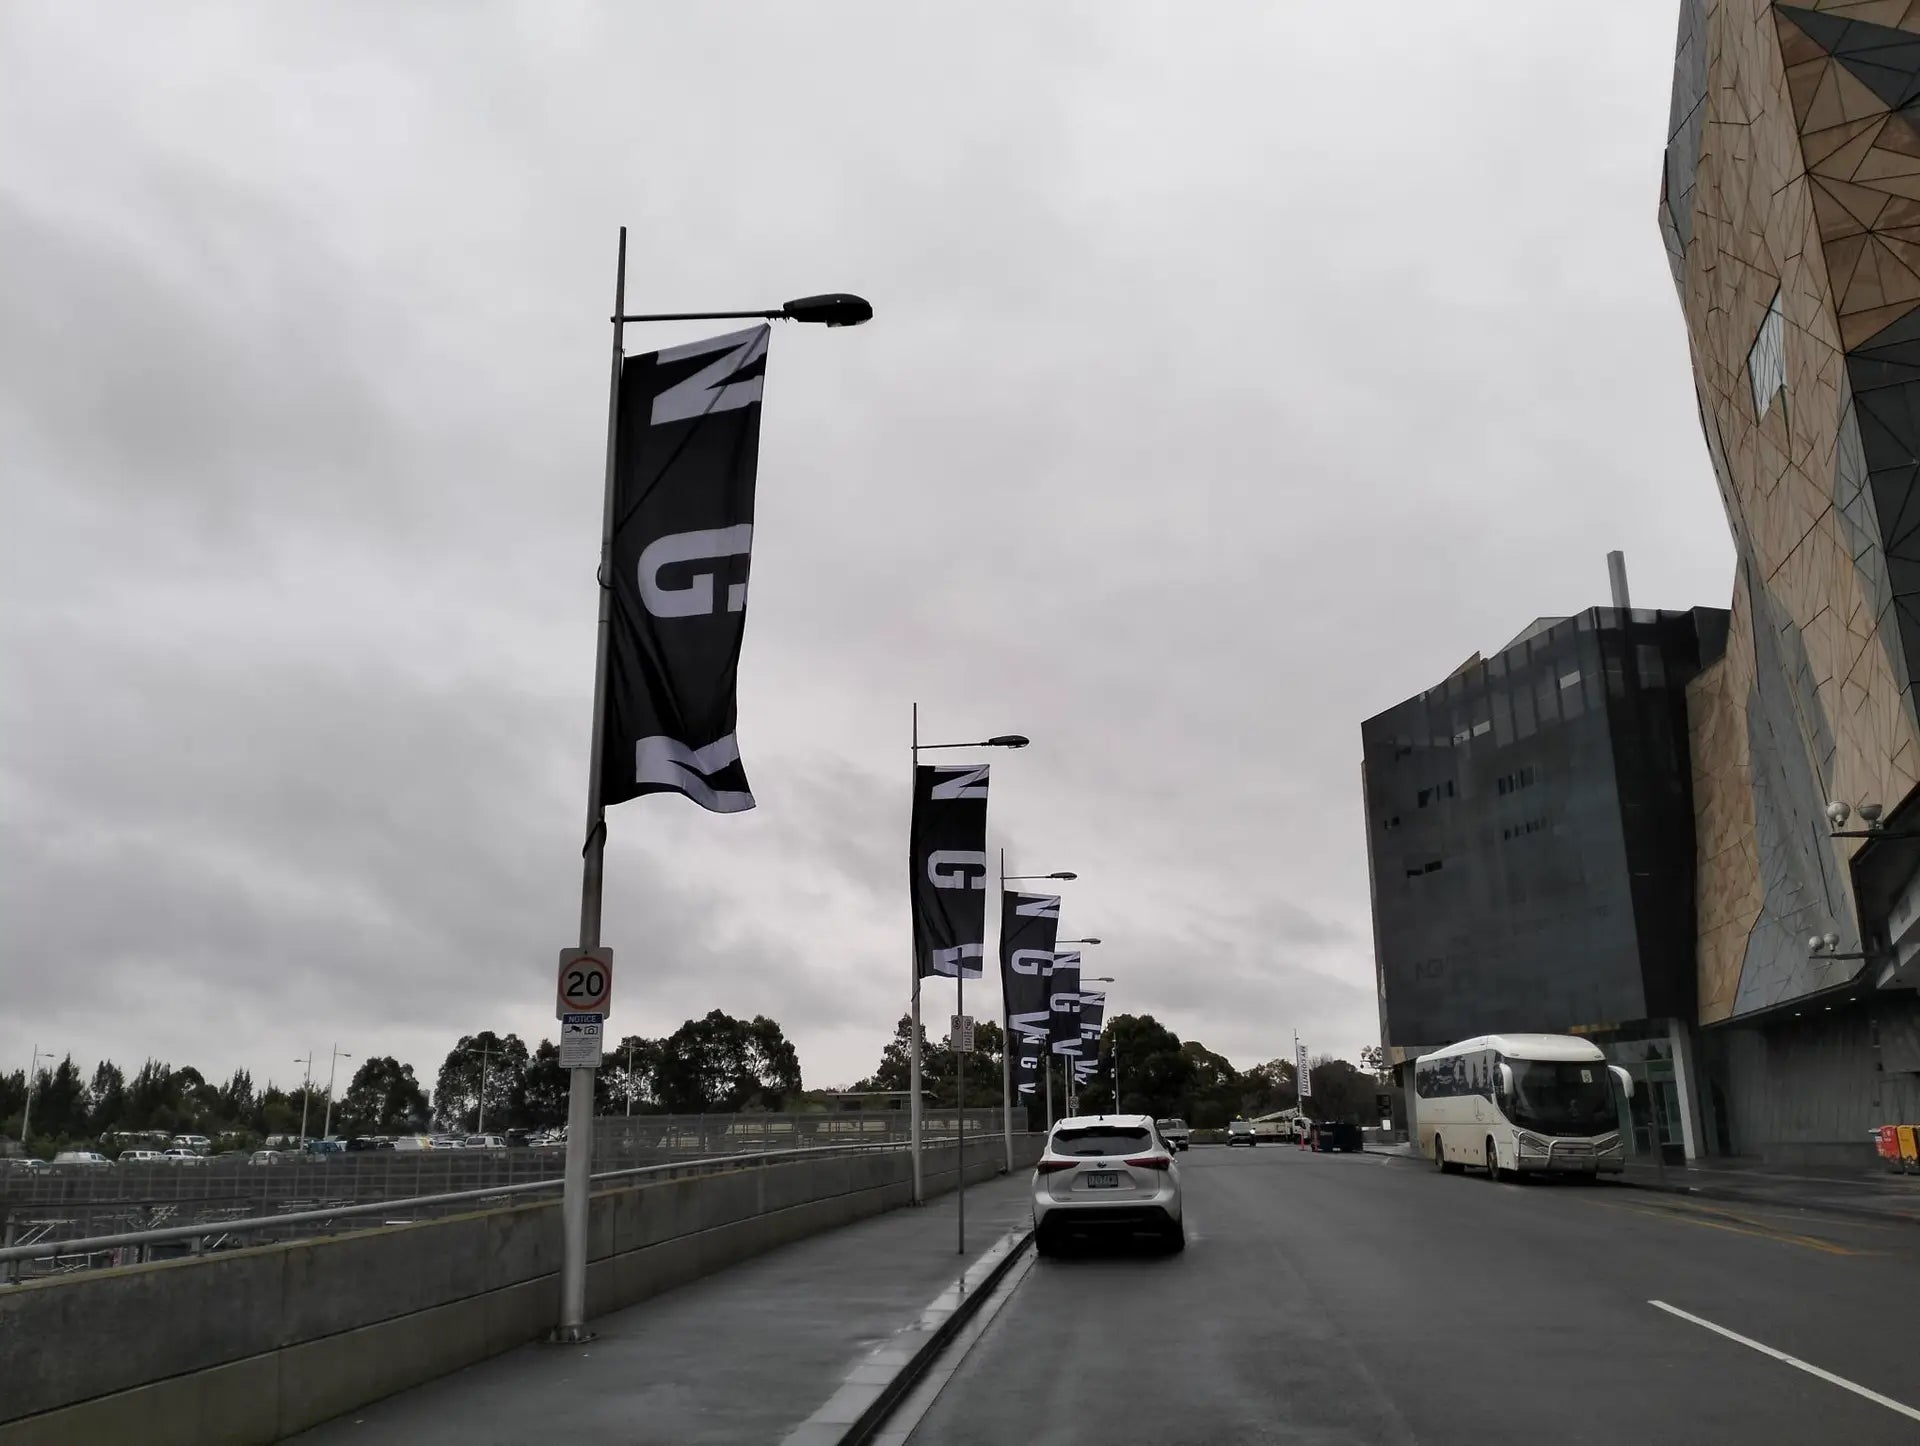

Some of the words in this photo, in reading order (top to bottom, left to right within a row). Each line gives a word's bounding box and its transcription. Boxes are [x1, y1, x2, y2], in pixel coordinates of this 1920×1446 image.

[927, 764, 990, 979] NGV
[566, 971, 604, 997] 20
[1009, 892, 1061, 1035] NGV
[1050, 951, 1084, 1056] NGV
[568, 1014, 597, 1023] NOTICE
[1018, 1032, 1040, 1094] NGV
